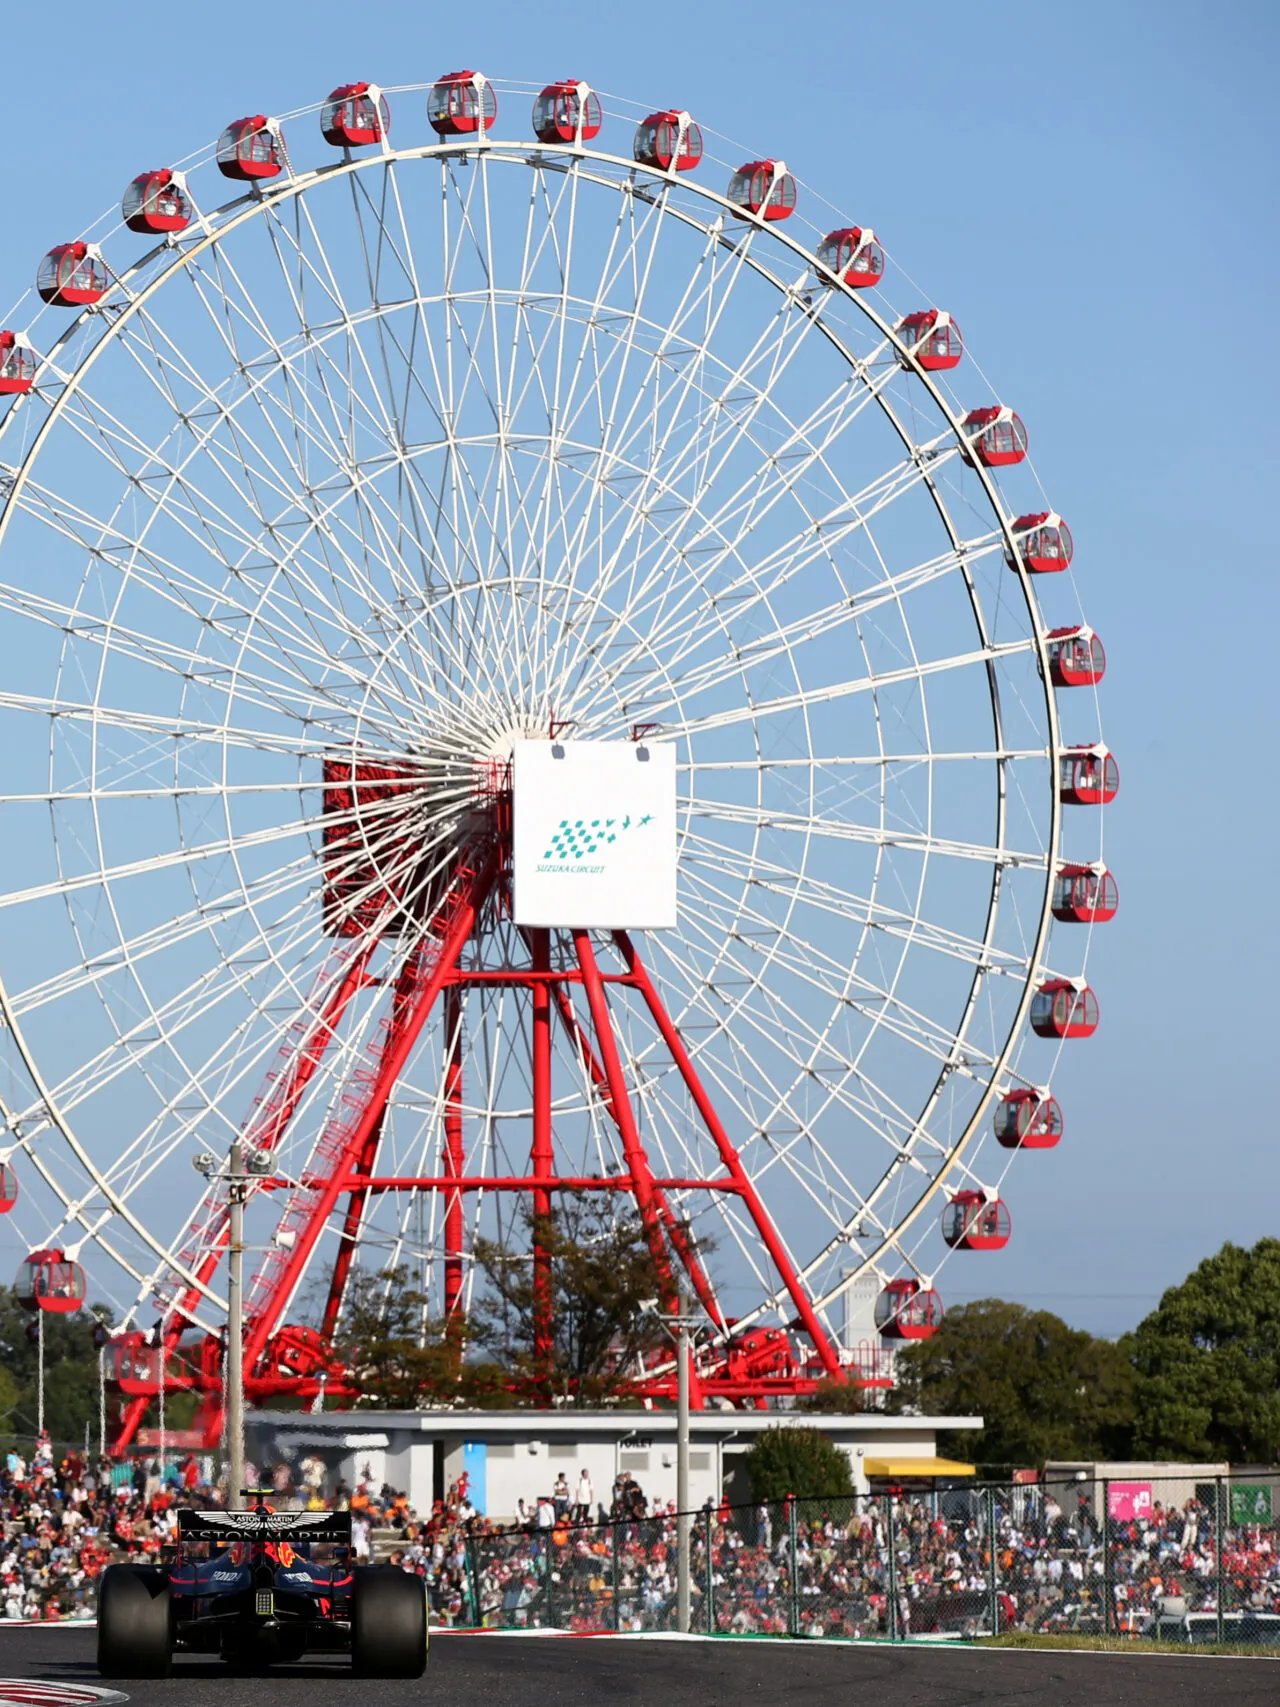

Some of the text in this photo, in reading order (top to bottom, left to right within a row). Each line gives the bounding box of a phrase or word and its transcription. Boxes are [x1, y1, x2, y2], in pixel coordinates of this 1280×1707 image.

[535, 864, 606, 874] SUZUKA CIRCUIT
[183, 1530, 259, 1540] ASTON
